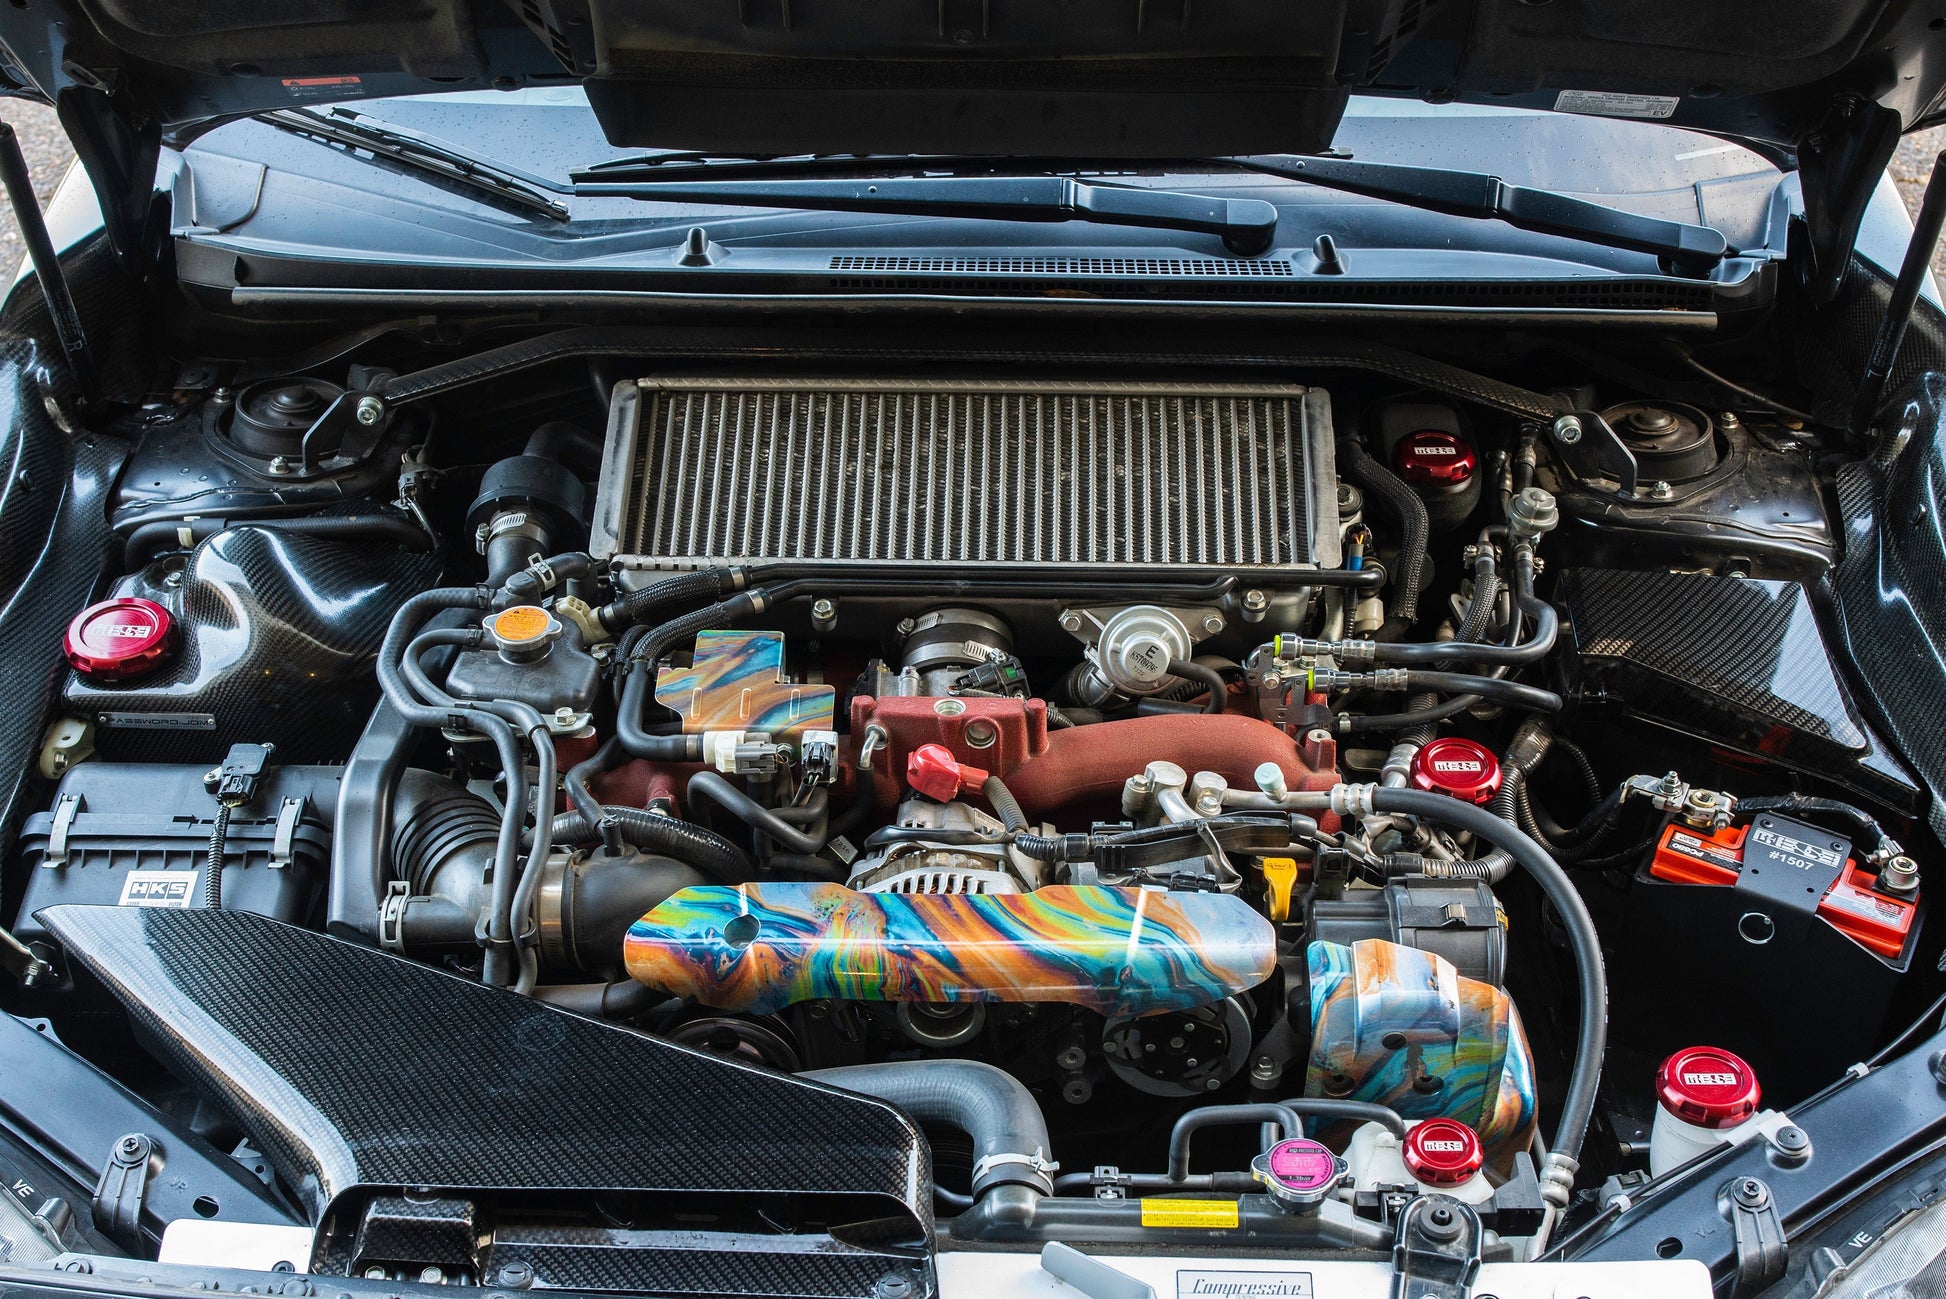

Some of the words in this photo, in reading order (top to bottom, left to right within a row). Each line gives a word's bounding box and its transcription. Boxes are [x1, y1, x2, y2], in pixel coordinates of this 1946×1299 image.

[1145, 645, 1159, 659] E
[1768, 850, 1814, 870] #1507
[128, 881, 189, 899] HKS
[12, 1178, 35, 1198] VE
[1848, 1231, 1873, 1248] VE
